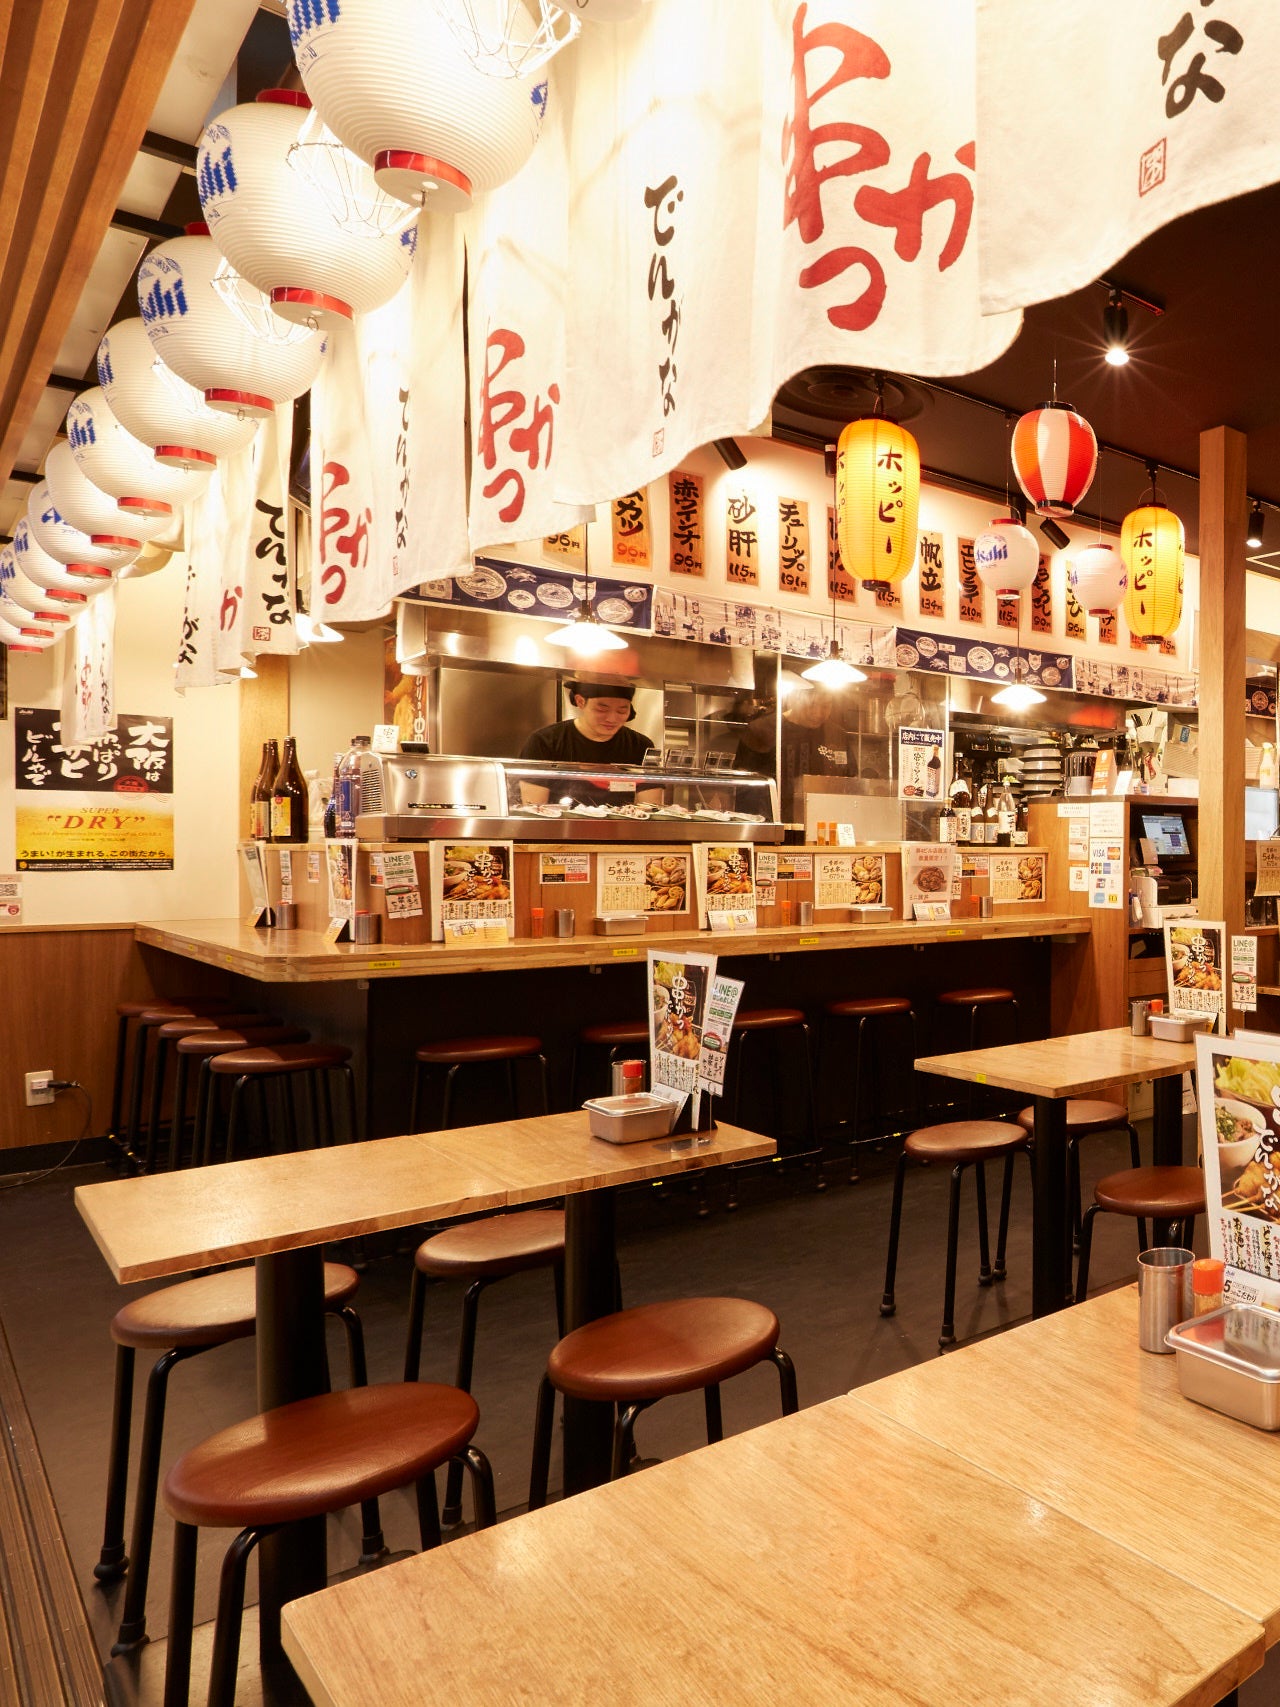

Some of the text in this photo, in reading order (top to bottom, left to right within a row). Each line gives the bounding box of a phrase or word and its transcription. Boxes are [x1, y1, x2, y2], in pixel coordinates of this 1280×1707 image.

[1158, 12, 1244, 119] な
[643, 174, 684, 418] でんがな
[672, 478, 701, 553] 赤ウインナー
[728, 494, 758, 558] 砂肝
[877, 443, 903, 554] ホッピー
[778, 502, 805, 572] チューリップ
[920, 536, 942, 592] 帆立
[1133, 527, 1154, 615] ホッピー
[125, 721, 170, 783] 大阪は
[671, 970, 689, 1031] 串かつ
